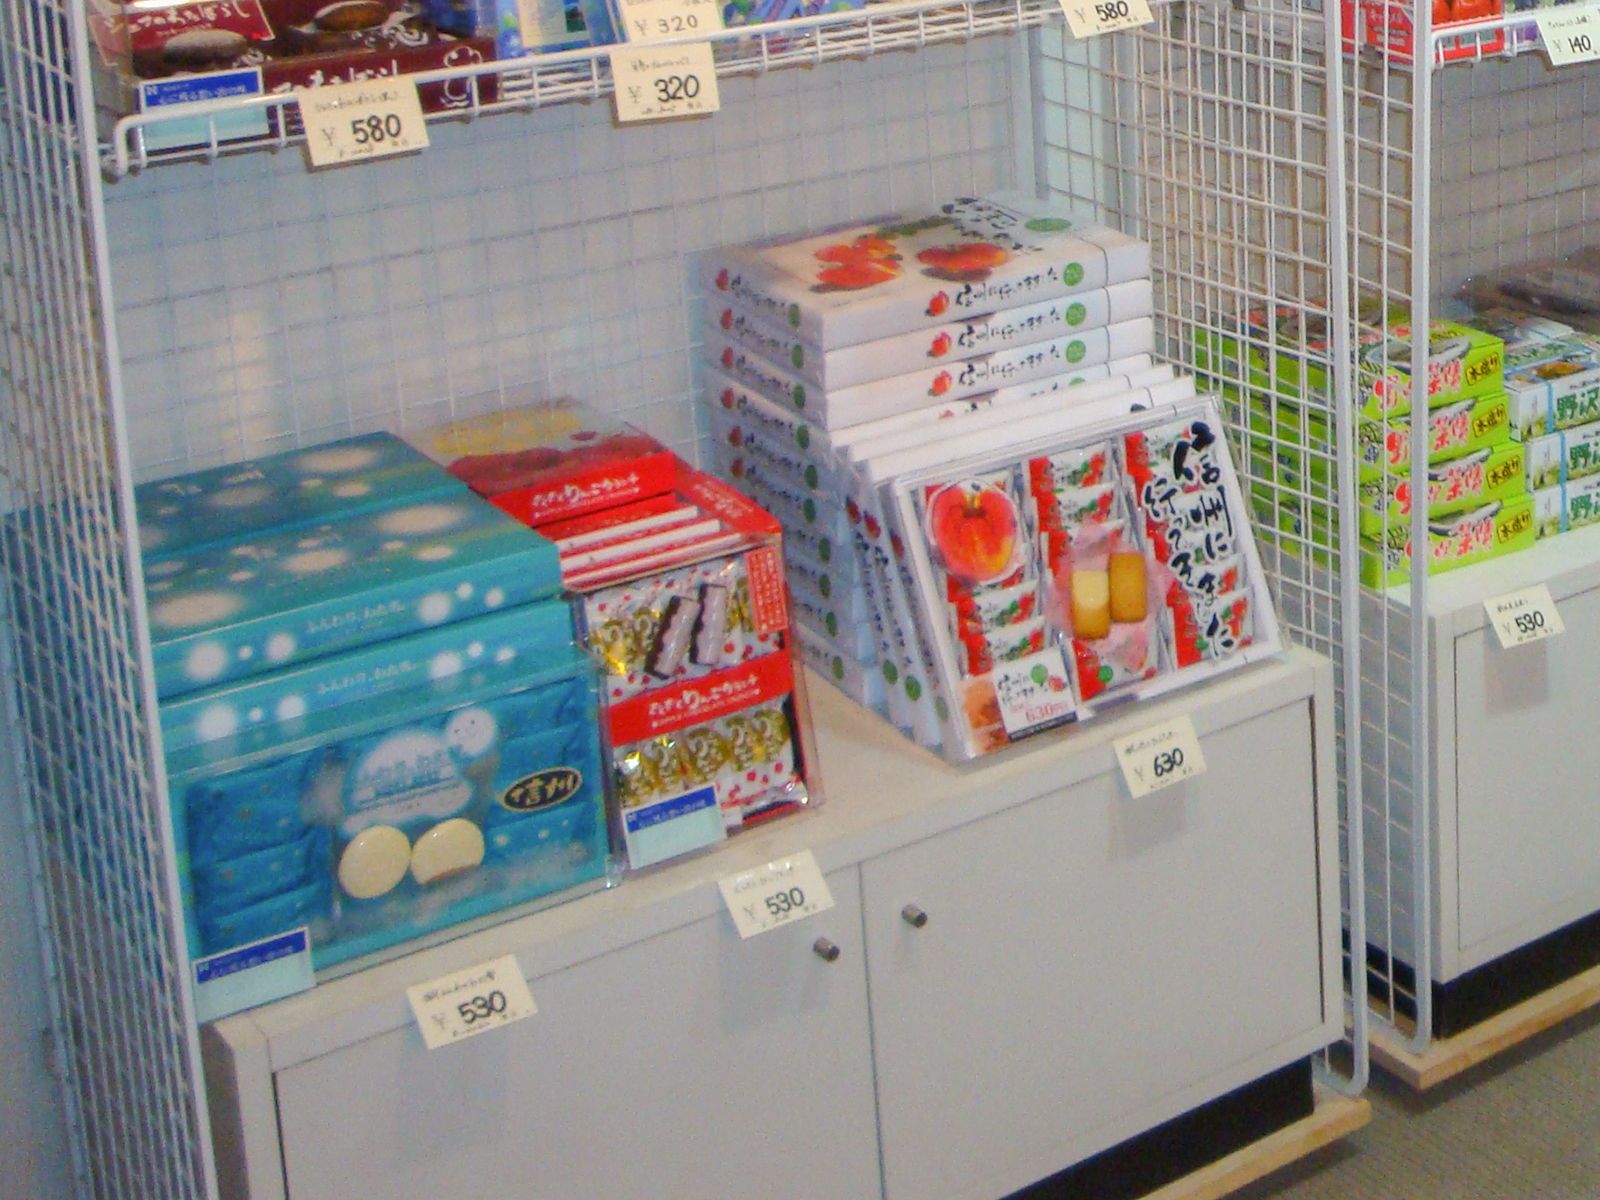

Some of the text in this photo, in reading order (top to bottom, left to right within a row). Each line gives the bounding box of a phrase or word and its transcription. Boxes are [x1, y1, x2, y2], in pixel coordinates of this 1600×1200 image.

[657, 13, 699, 34] 320
[1095, 0, 1130, 23] 580
[1568, 34, 1592, 54] 140
[653, 74, 701, 103] 320
[351, 112, 403, 145] 580
[1514, 610, 1545, 634] 530
[1152, 746, 1185, 778] 630
[763, 886, 807, 919] 530
[457, 989, 509, 1026] 530
